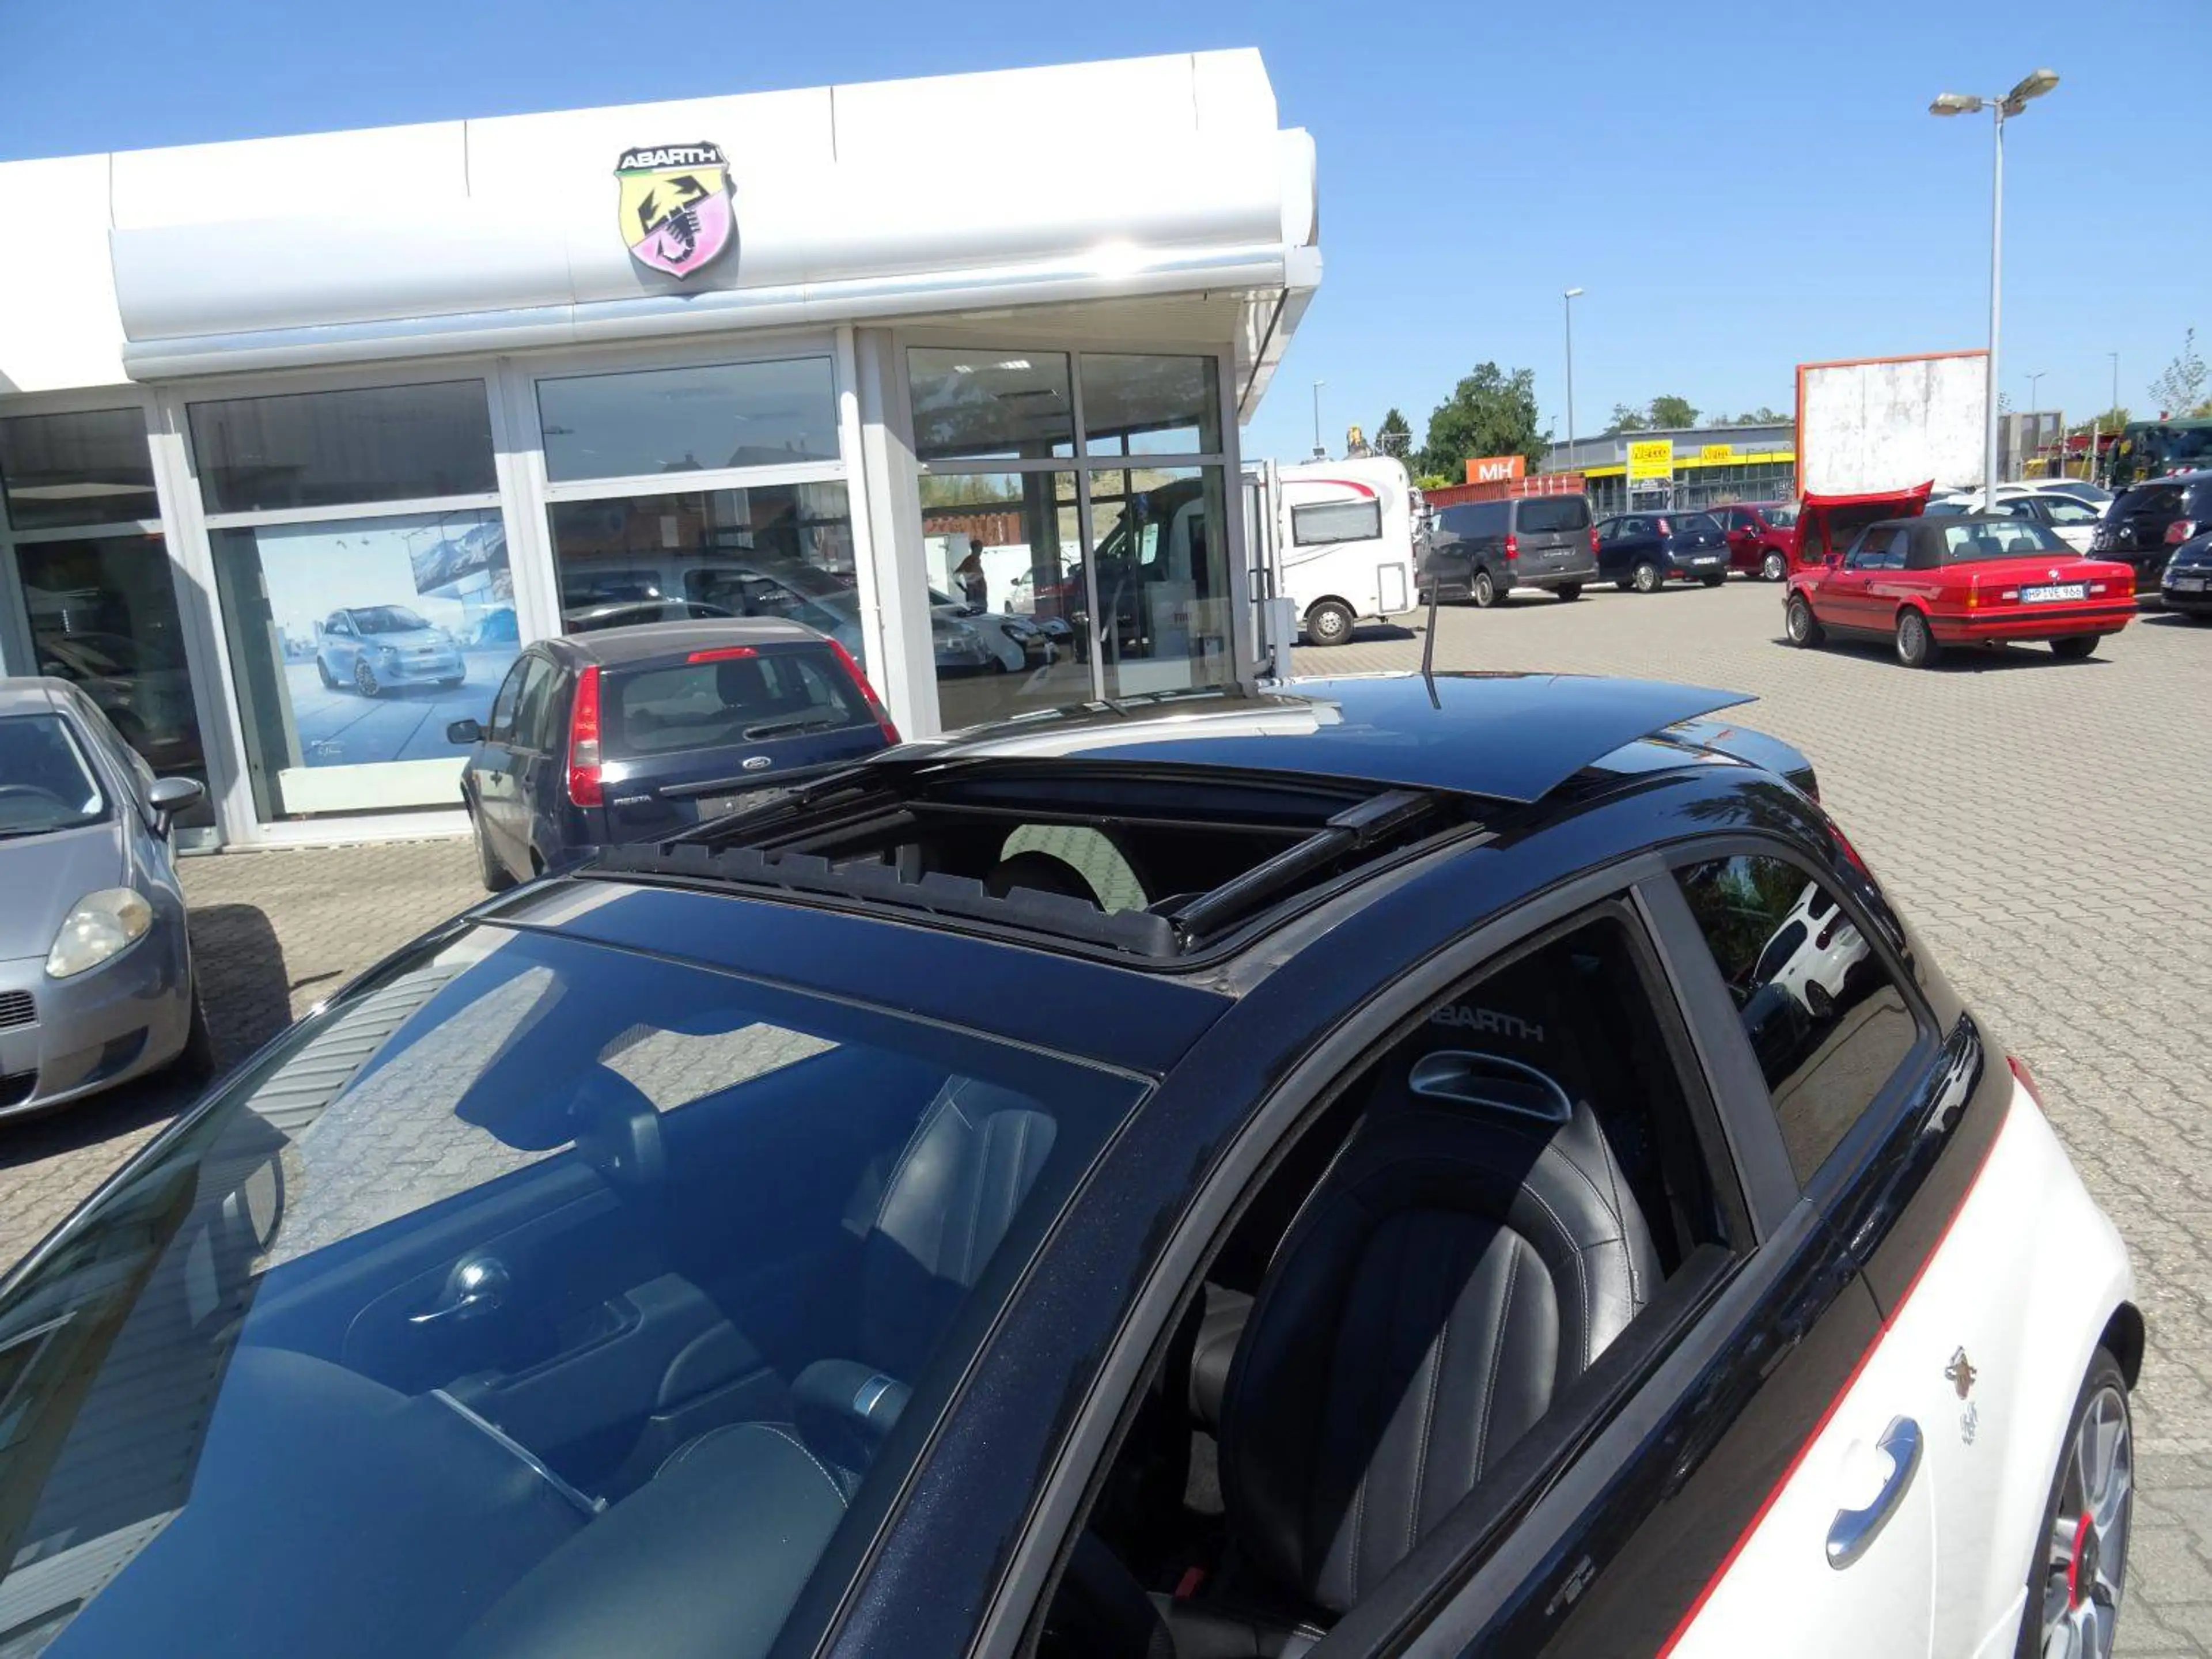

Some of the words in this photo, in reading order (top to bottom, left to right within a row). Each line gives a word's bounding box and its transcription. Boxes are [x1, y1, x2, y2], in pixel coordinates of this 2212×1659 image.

[621, 148, 716, 168] ABARTH
[1479, 456, 1514, 480] MH
[1431, 1004, 1544, 1043] BARTH
